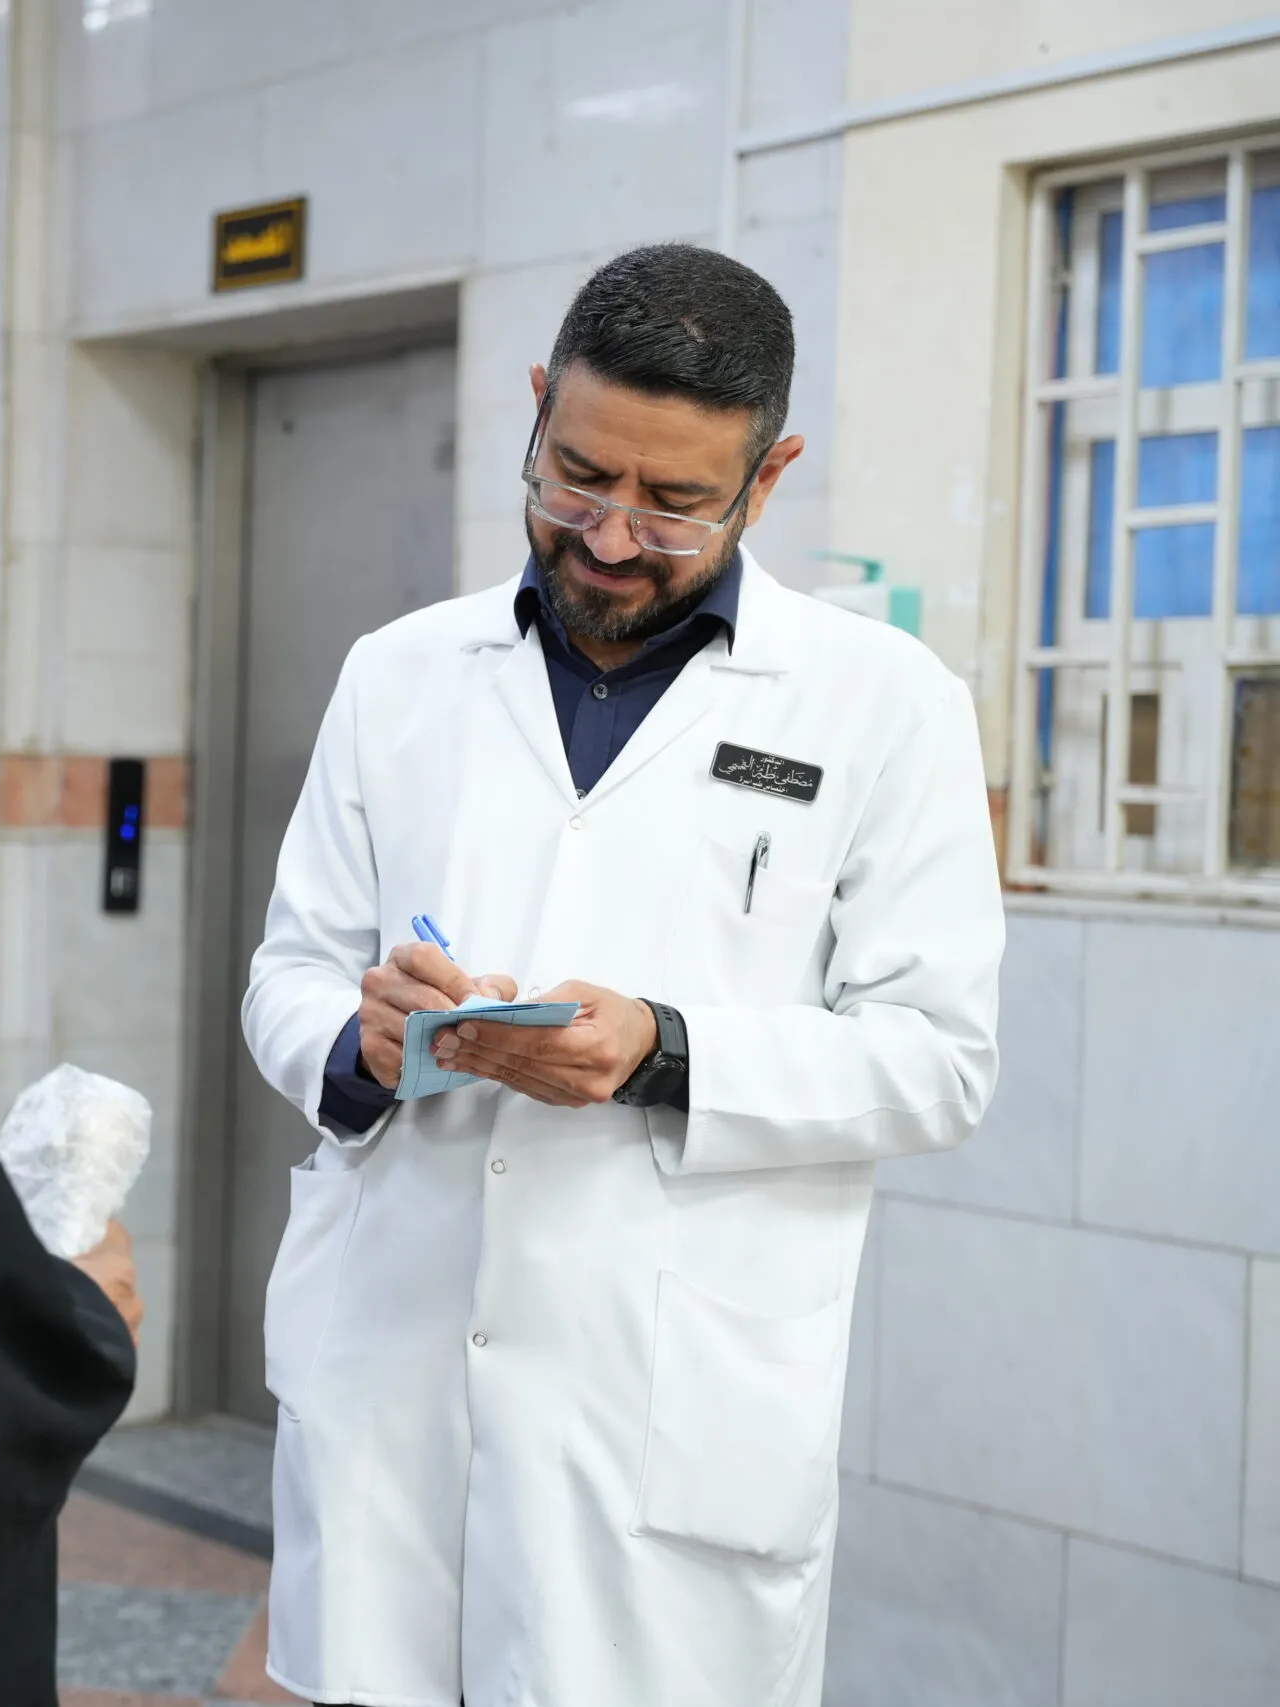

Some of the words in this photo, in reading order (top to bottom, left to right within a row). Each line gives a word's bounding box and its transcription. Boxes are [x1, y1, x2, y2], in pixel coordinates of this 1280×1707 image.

[760, 755, 785, 766] الدكتور
[773, 769, 813, 788] مصطفى
[752, 780, 763, 788] طب
[762, 784, 788, 793] اختصاص
